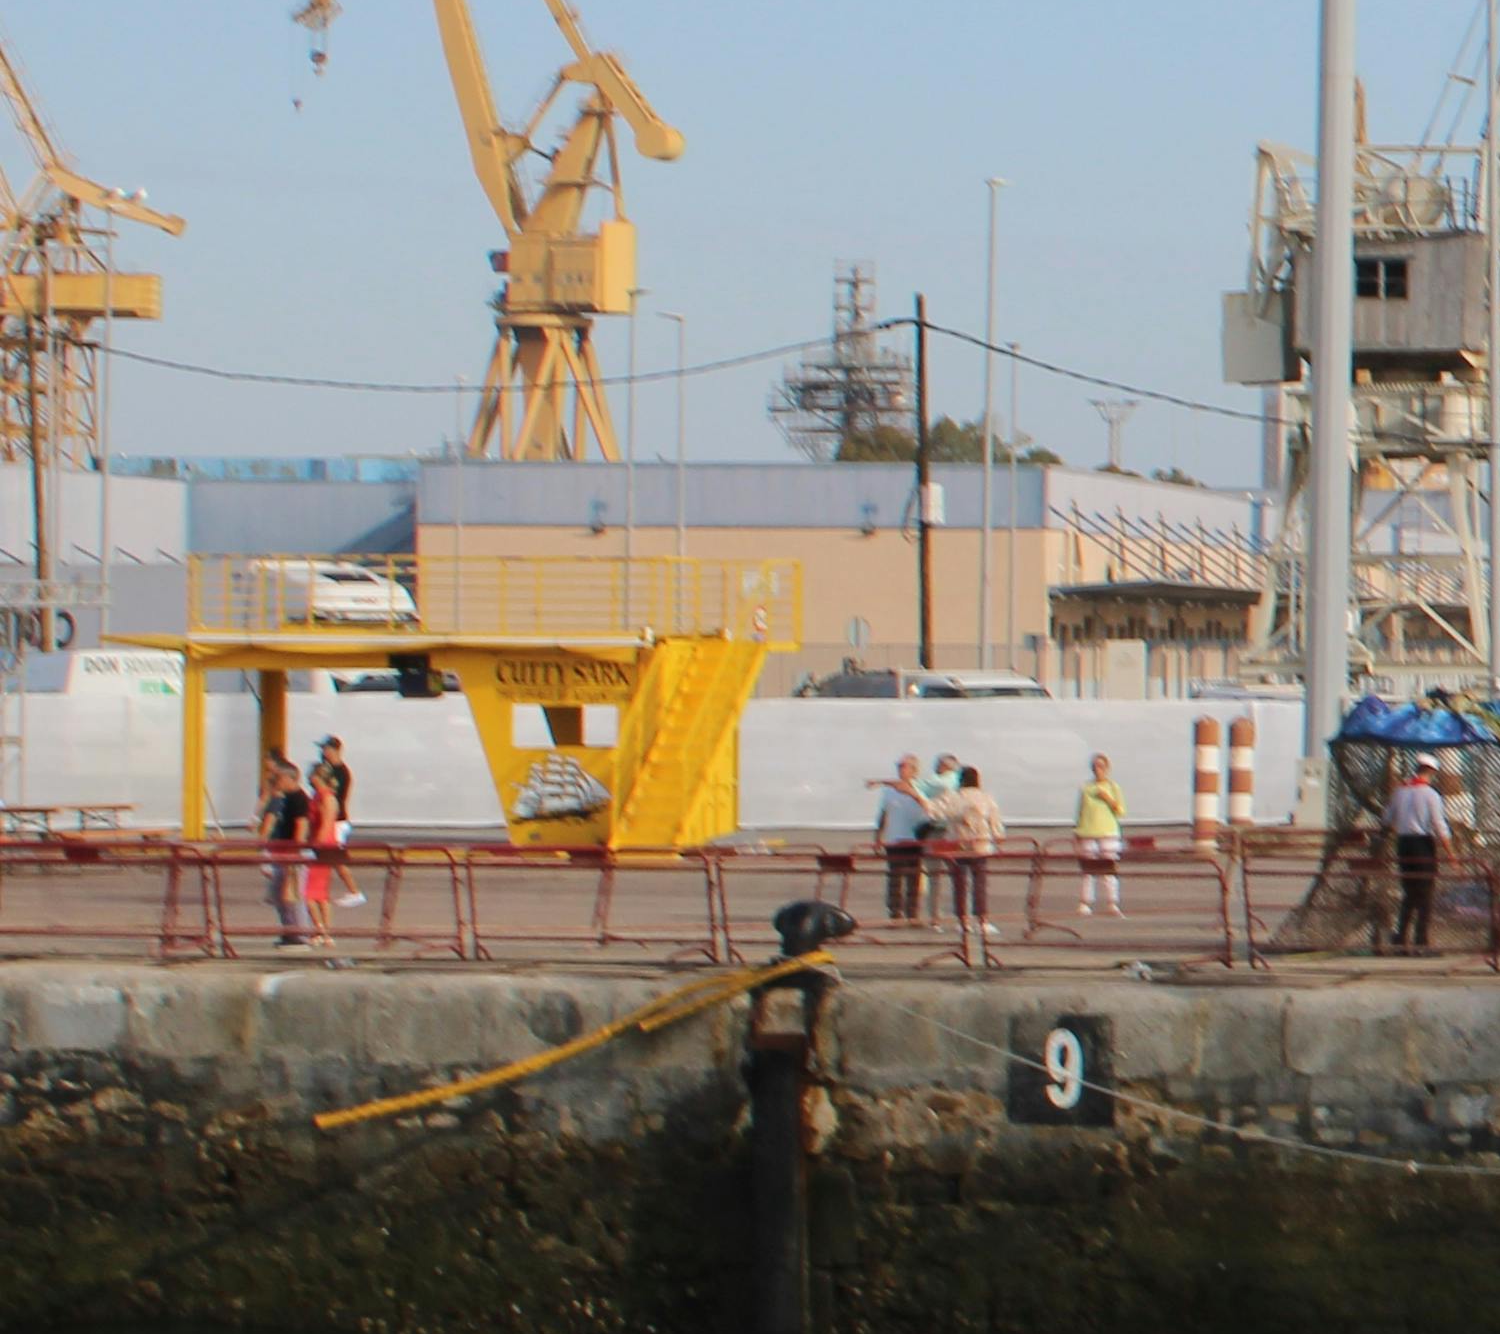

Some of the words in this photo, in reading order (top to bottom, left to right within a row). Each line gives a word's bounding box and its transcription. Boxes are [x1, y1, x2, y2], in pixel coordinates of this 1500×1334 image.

[496, 659, 566, 685] CUTTY
[573, 660, 630, 686] SARK
[1045, 1028, 1082, 1109] 9
